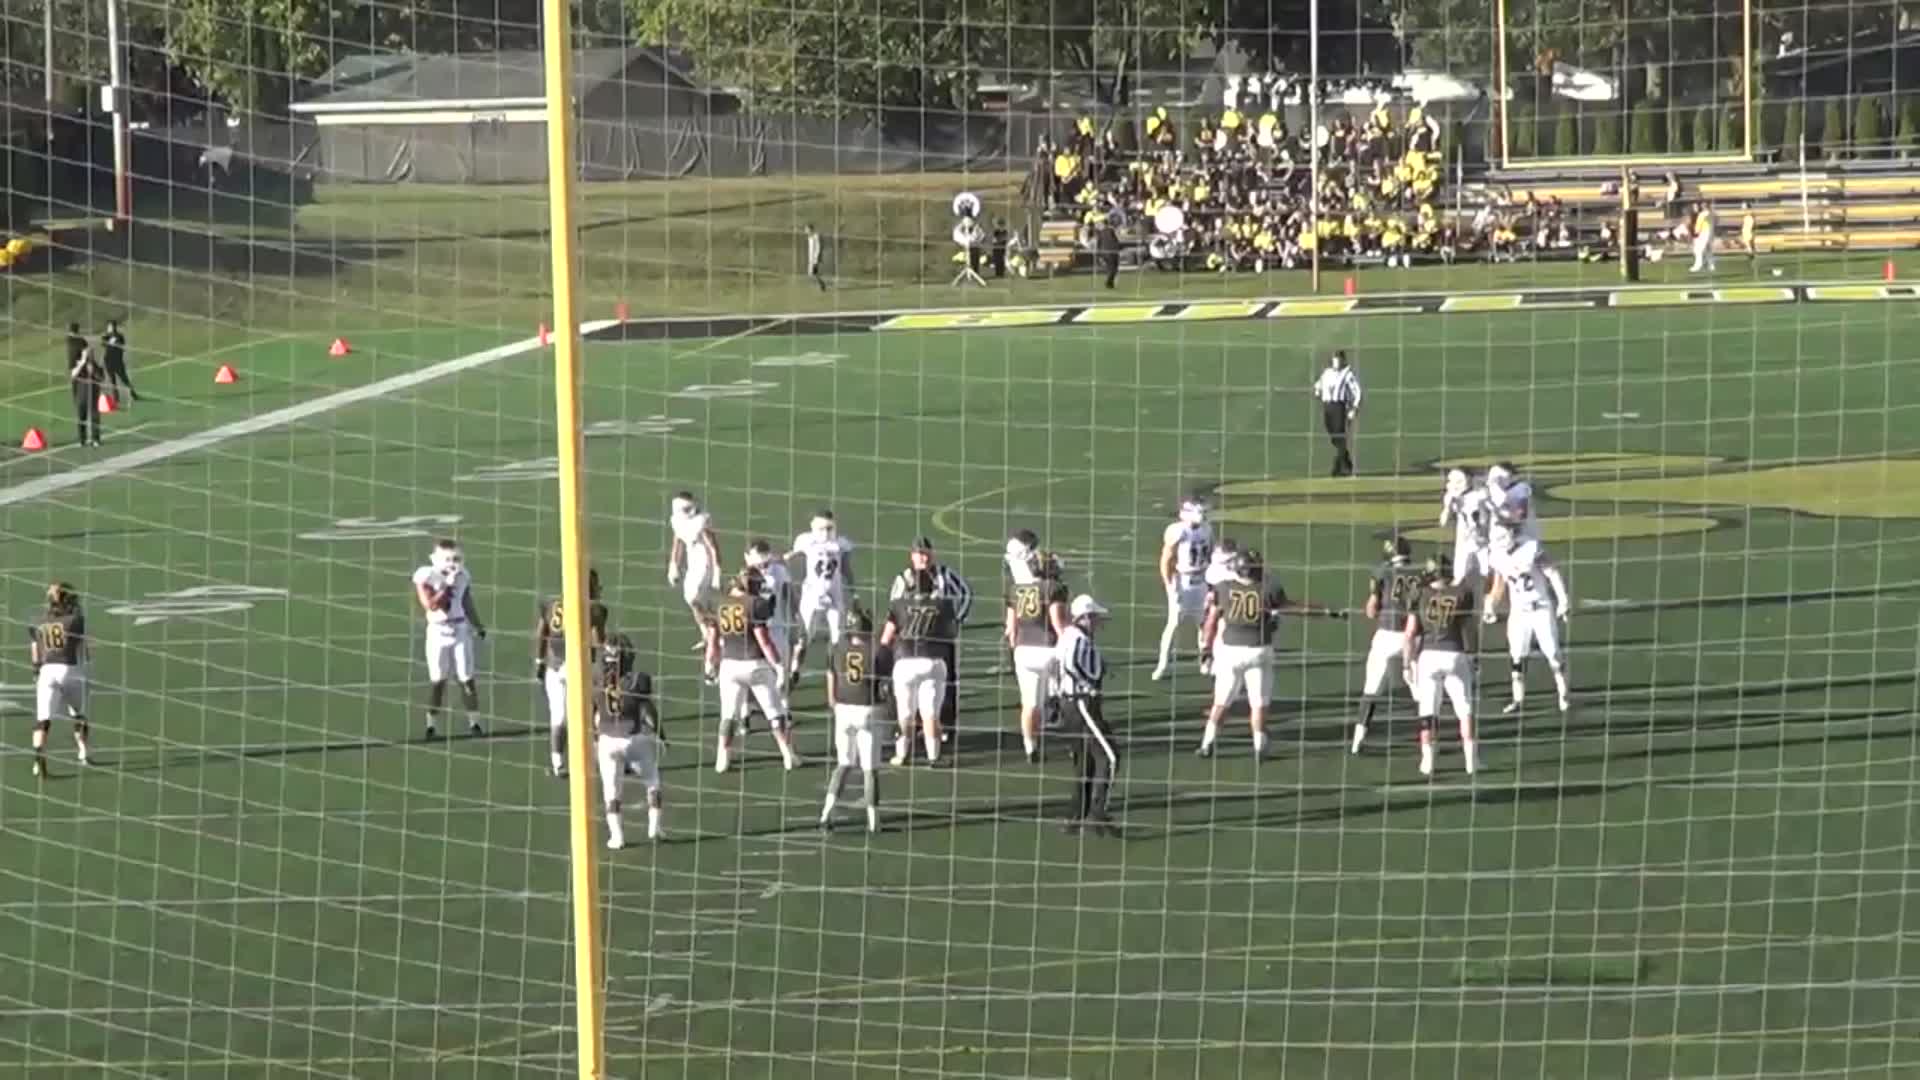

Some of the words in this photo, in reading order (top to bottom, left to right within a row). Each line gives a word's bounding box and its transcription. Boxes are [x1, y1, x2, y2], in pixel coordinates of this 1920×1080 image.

[1016, 586, 1040, 618] 73
[1228, 589, 1260, 624] 70
[719, 603, 745, 635] 56
[904, 605, 940, 638] 77
[846, 651, 864, 685] 5
